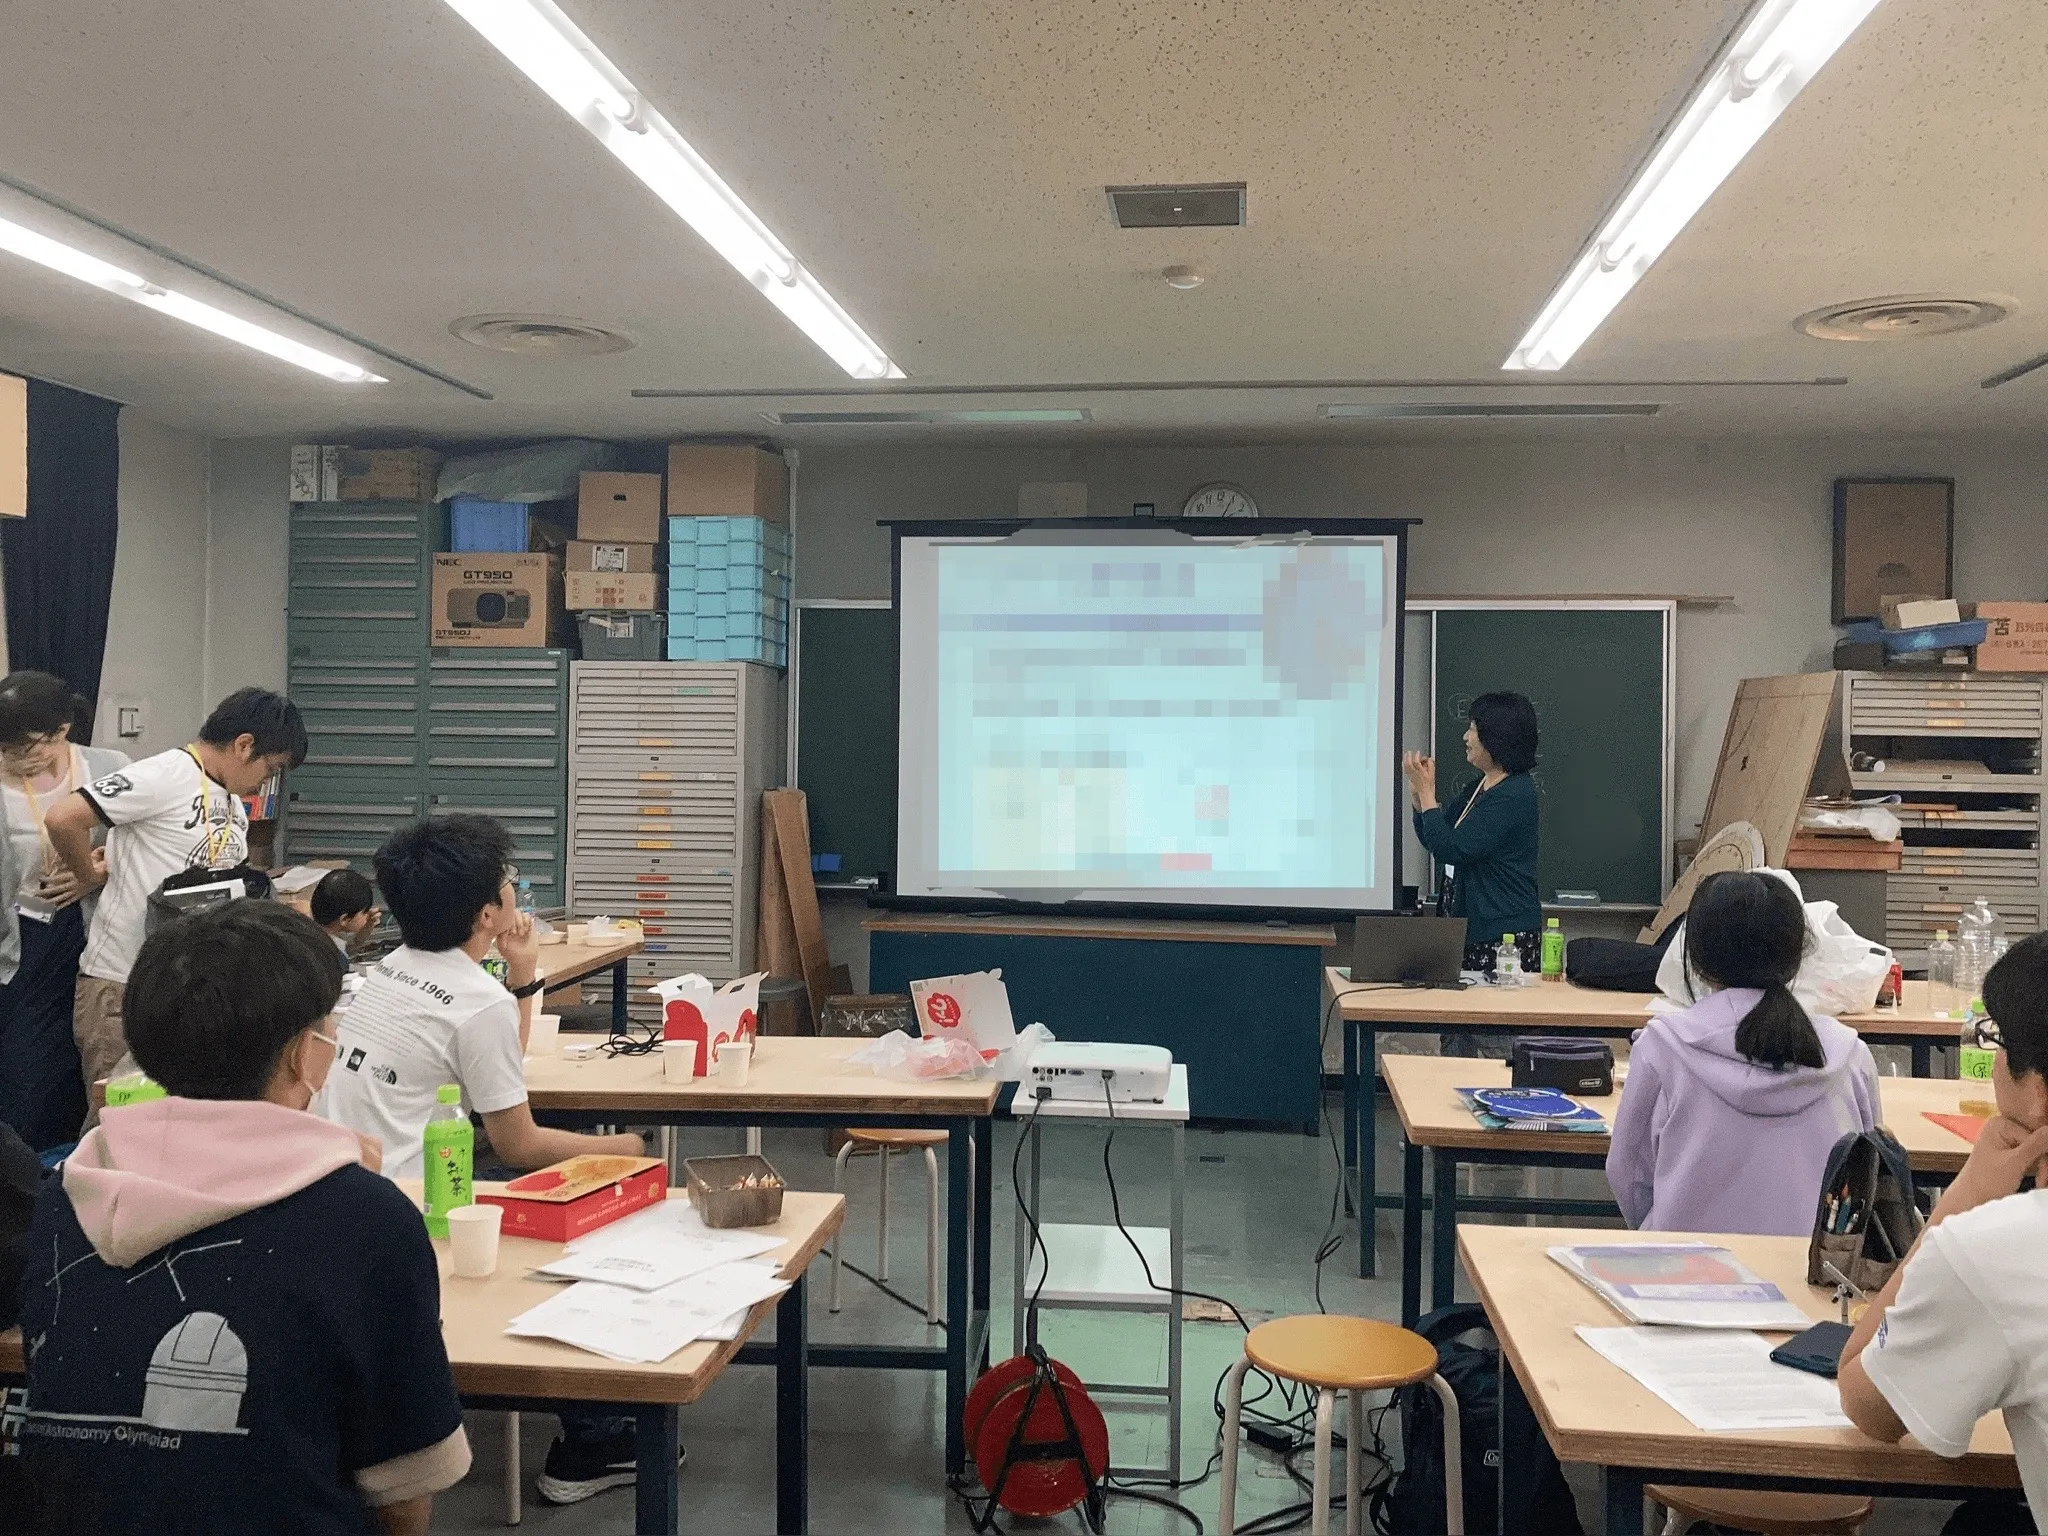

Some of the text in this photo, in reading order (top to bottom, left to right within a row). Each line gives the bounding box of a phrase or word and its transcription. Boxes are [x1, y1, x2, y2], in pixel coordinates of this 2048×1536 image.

[436, 559, 461, 567] NEC
[463, 570, 513, 580] GT950
[419, 981, 454, 1005] 1966
[113, 1425, 181, 1450] Olympiad
